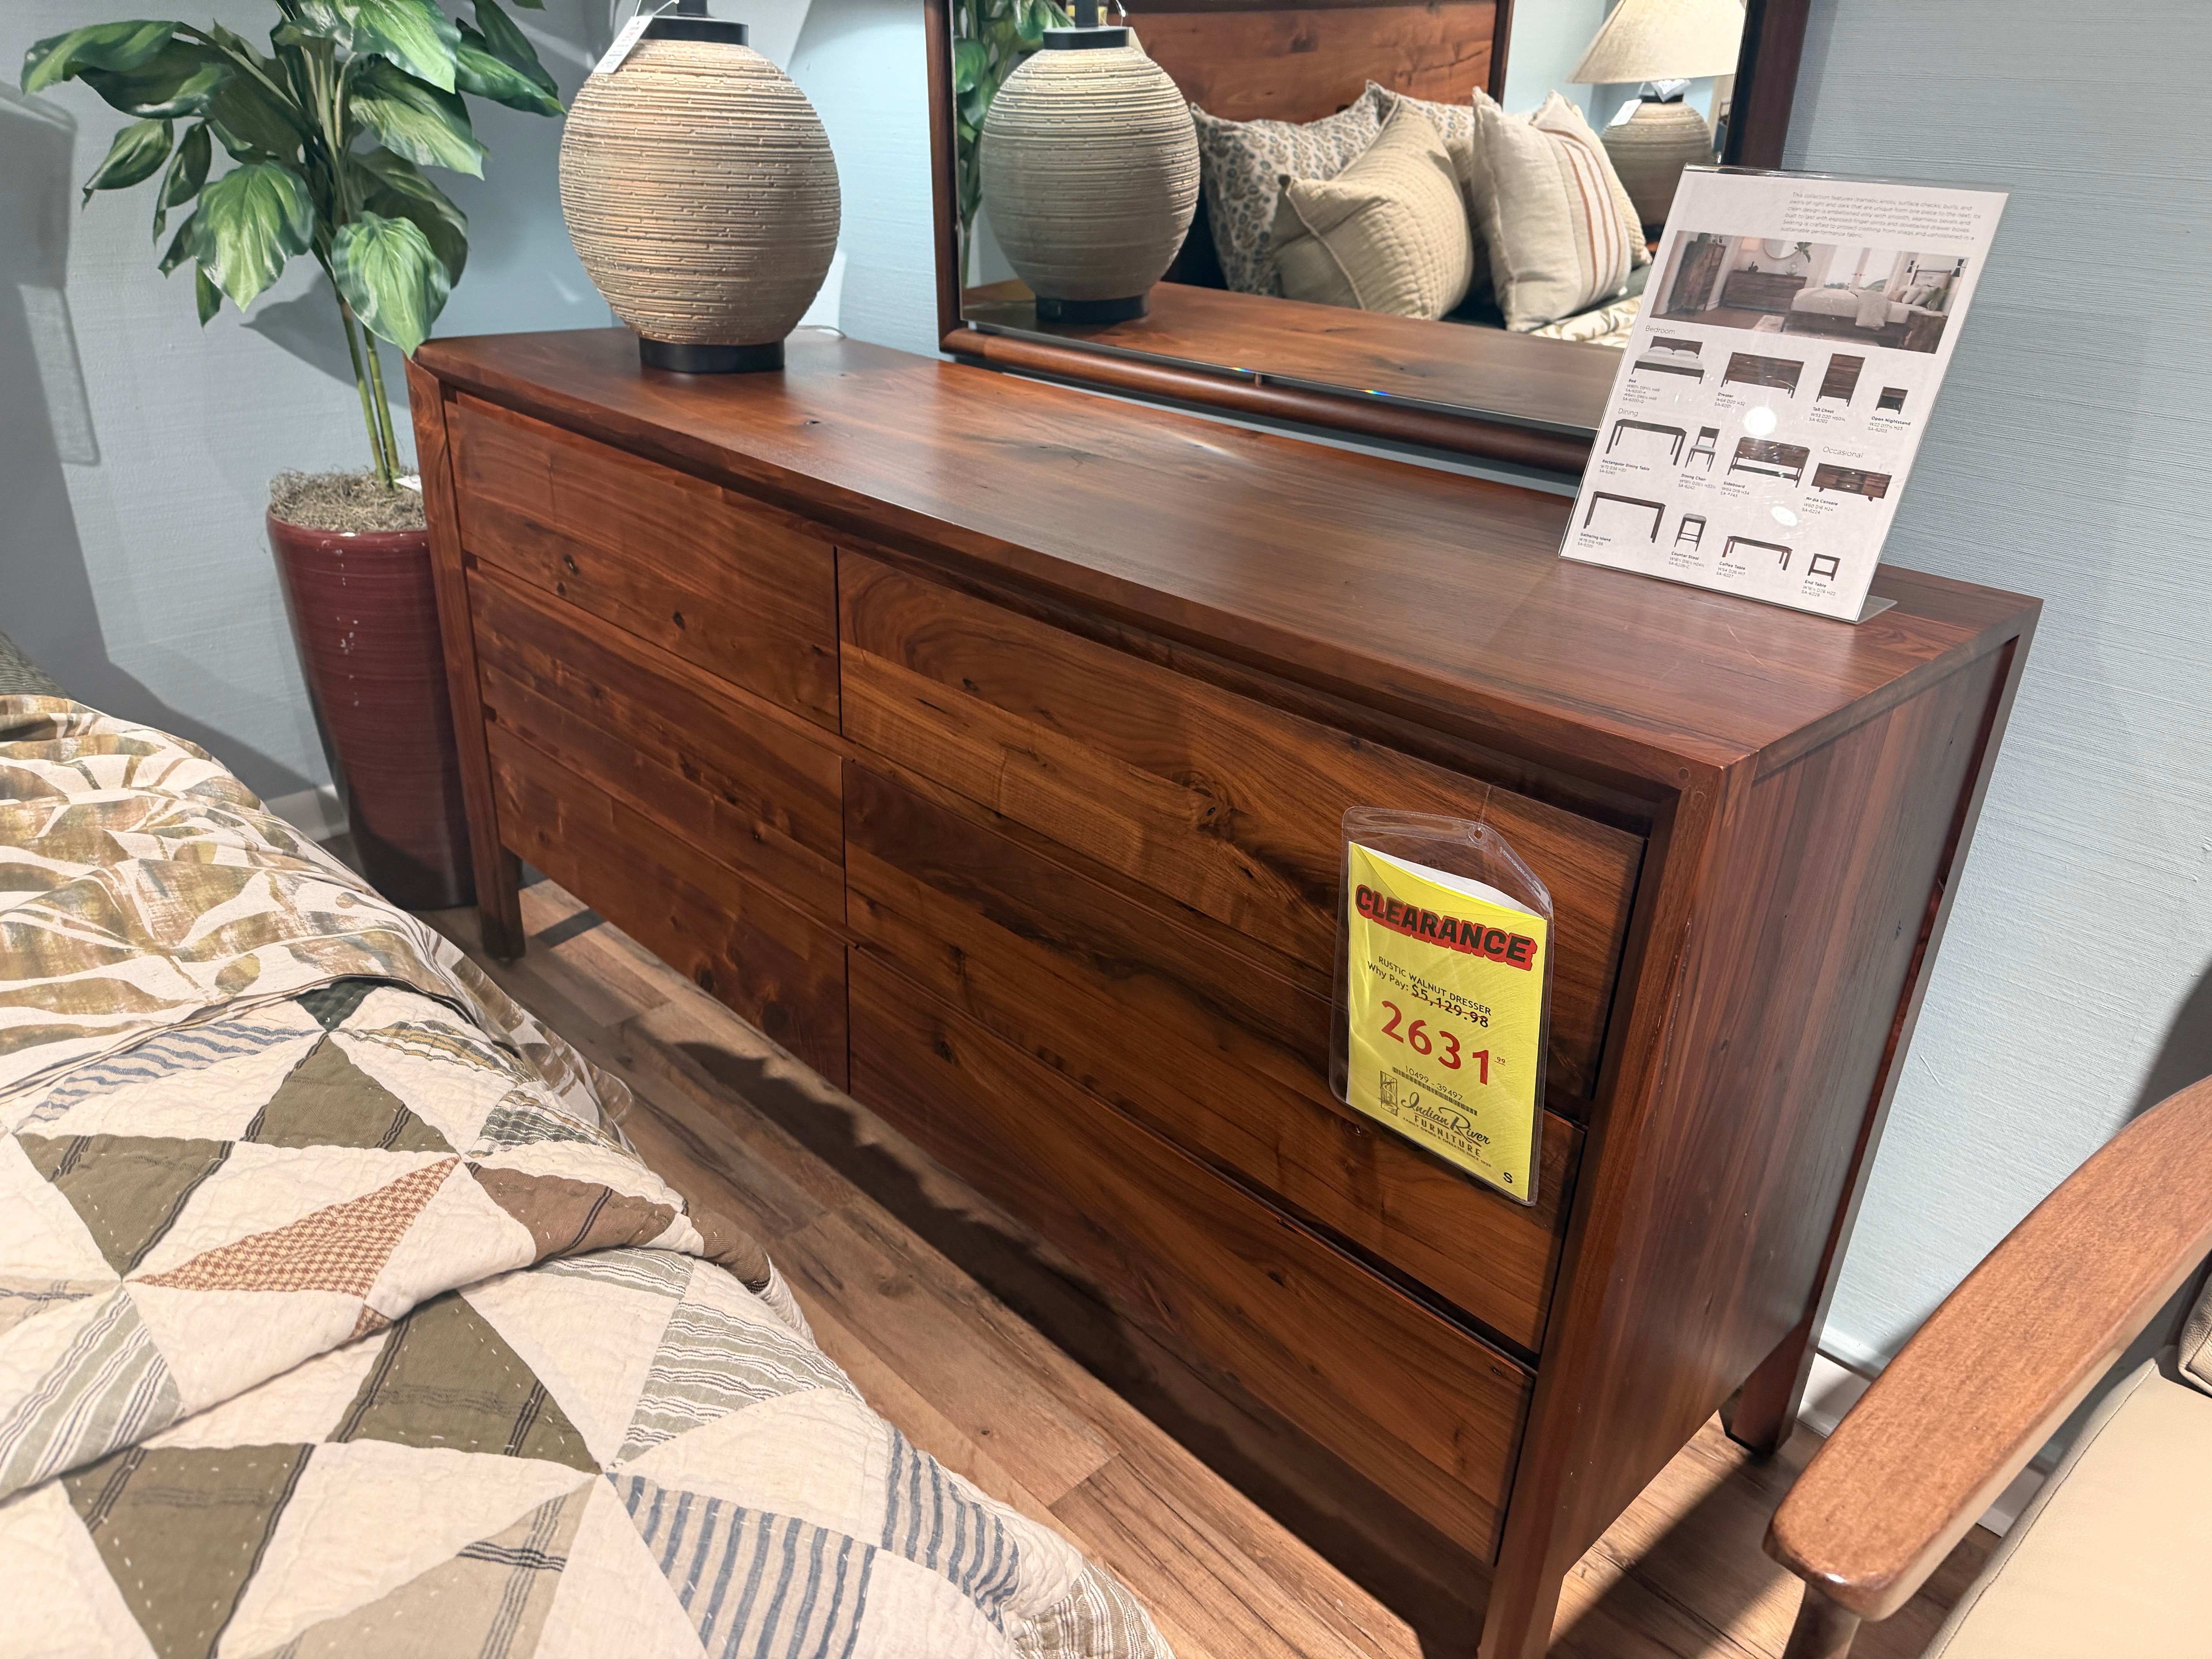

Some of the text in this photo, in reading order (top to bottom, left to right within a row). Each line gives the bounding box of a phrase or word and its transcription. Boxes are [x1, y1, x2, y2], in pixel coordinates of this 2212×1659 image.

[1645, 325, 1675, 335] Bedroom
[1618, 408, 1638, 417] Dining
[1823, 446, 1863, 458] Occasional
[1357, 886, 1533, 964] CLEARANCE
[1367, 961, 1489, 1028] Why Pay: $5,129.98
[1379, 956, 1492, 1016] RUSTIC WALNUT DRESSER
[1381, 1000, 1489, 1085] 2631
[1405, 1065, 1429, 1083] 10499
[1436, 1083, 1463, 1101] 39497
[1401, 1092, 1491, 1145] Indian River
[1414, 1115, 1481, 1158] FURNITURE
[1420, 1127, 1436, 1137] OWNED
[1442, 1138, 1465, 1153] OPERATED
[1503, 1172, 1513, 1183] S
